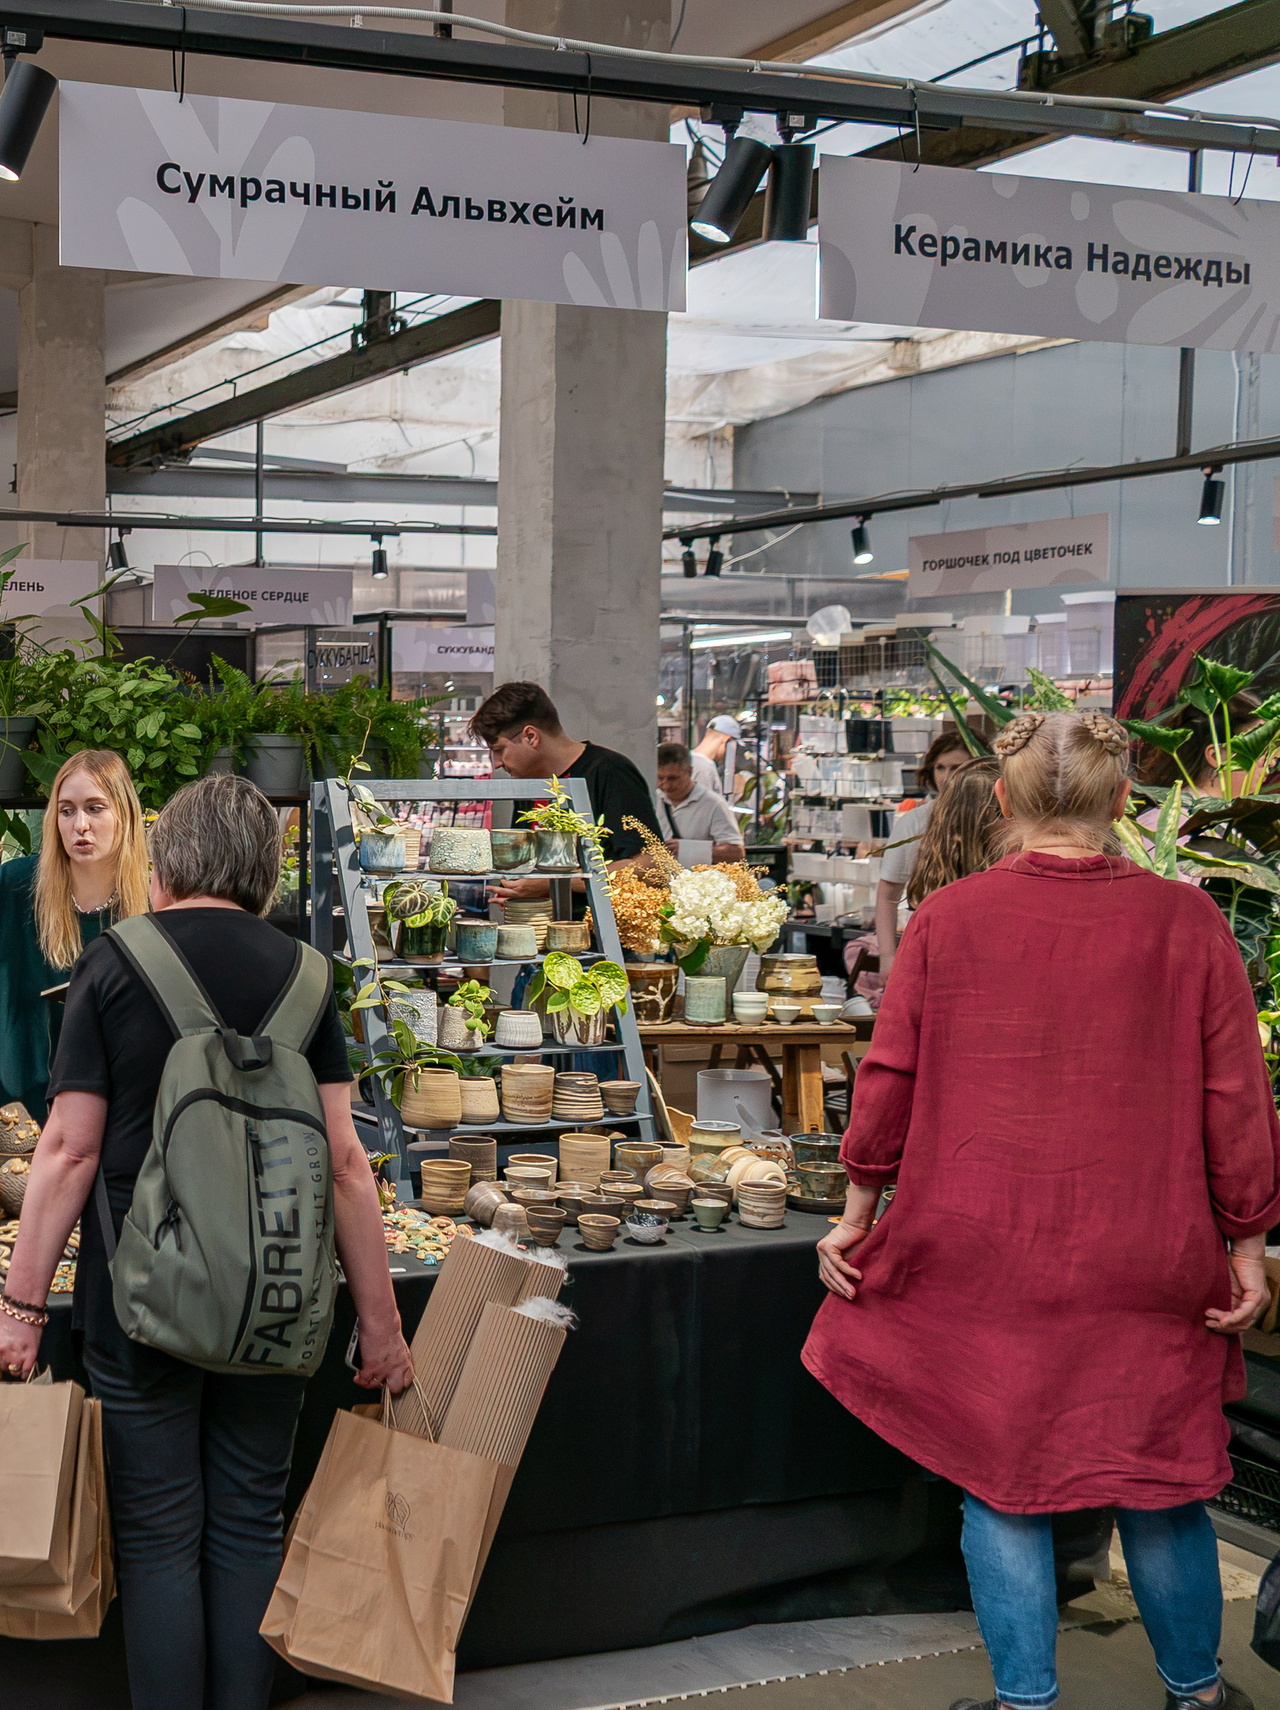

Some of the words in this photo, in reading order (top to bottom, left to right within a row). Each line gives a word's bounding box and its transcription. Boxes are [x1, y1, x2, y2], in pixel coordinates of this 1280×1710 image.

[155, 161, 398, 214] Сумрачный
[410, 185, 605, 231] Альвхейм
[893, 223, 1073, 270] Керамика
[1086, 241, 1251, 288] Надежды
[922, 553, 990, 573] ГОРШОЧЕК
[993, 550, 1021, 565] ПОД
[1024, 542, 1094, 563] ЦВЕТОЧЕК
[1, 580, 45, 592] ЕЛЕНЬ
[261, 590, 310, 604] СЕРДЦЕ
[437, 645, 495, 656] СУККУБАНД
[302, 1131, 323, 1183] GROW
